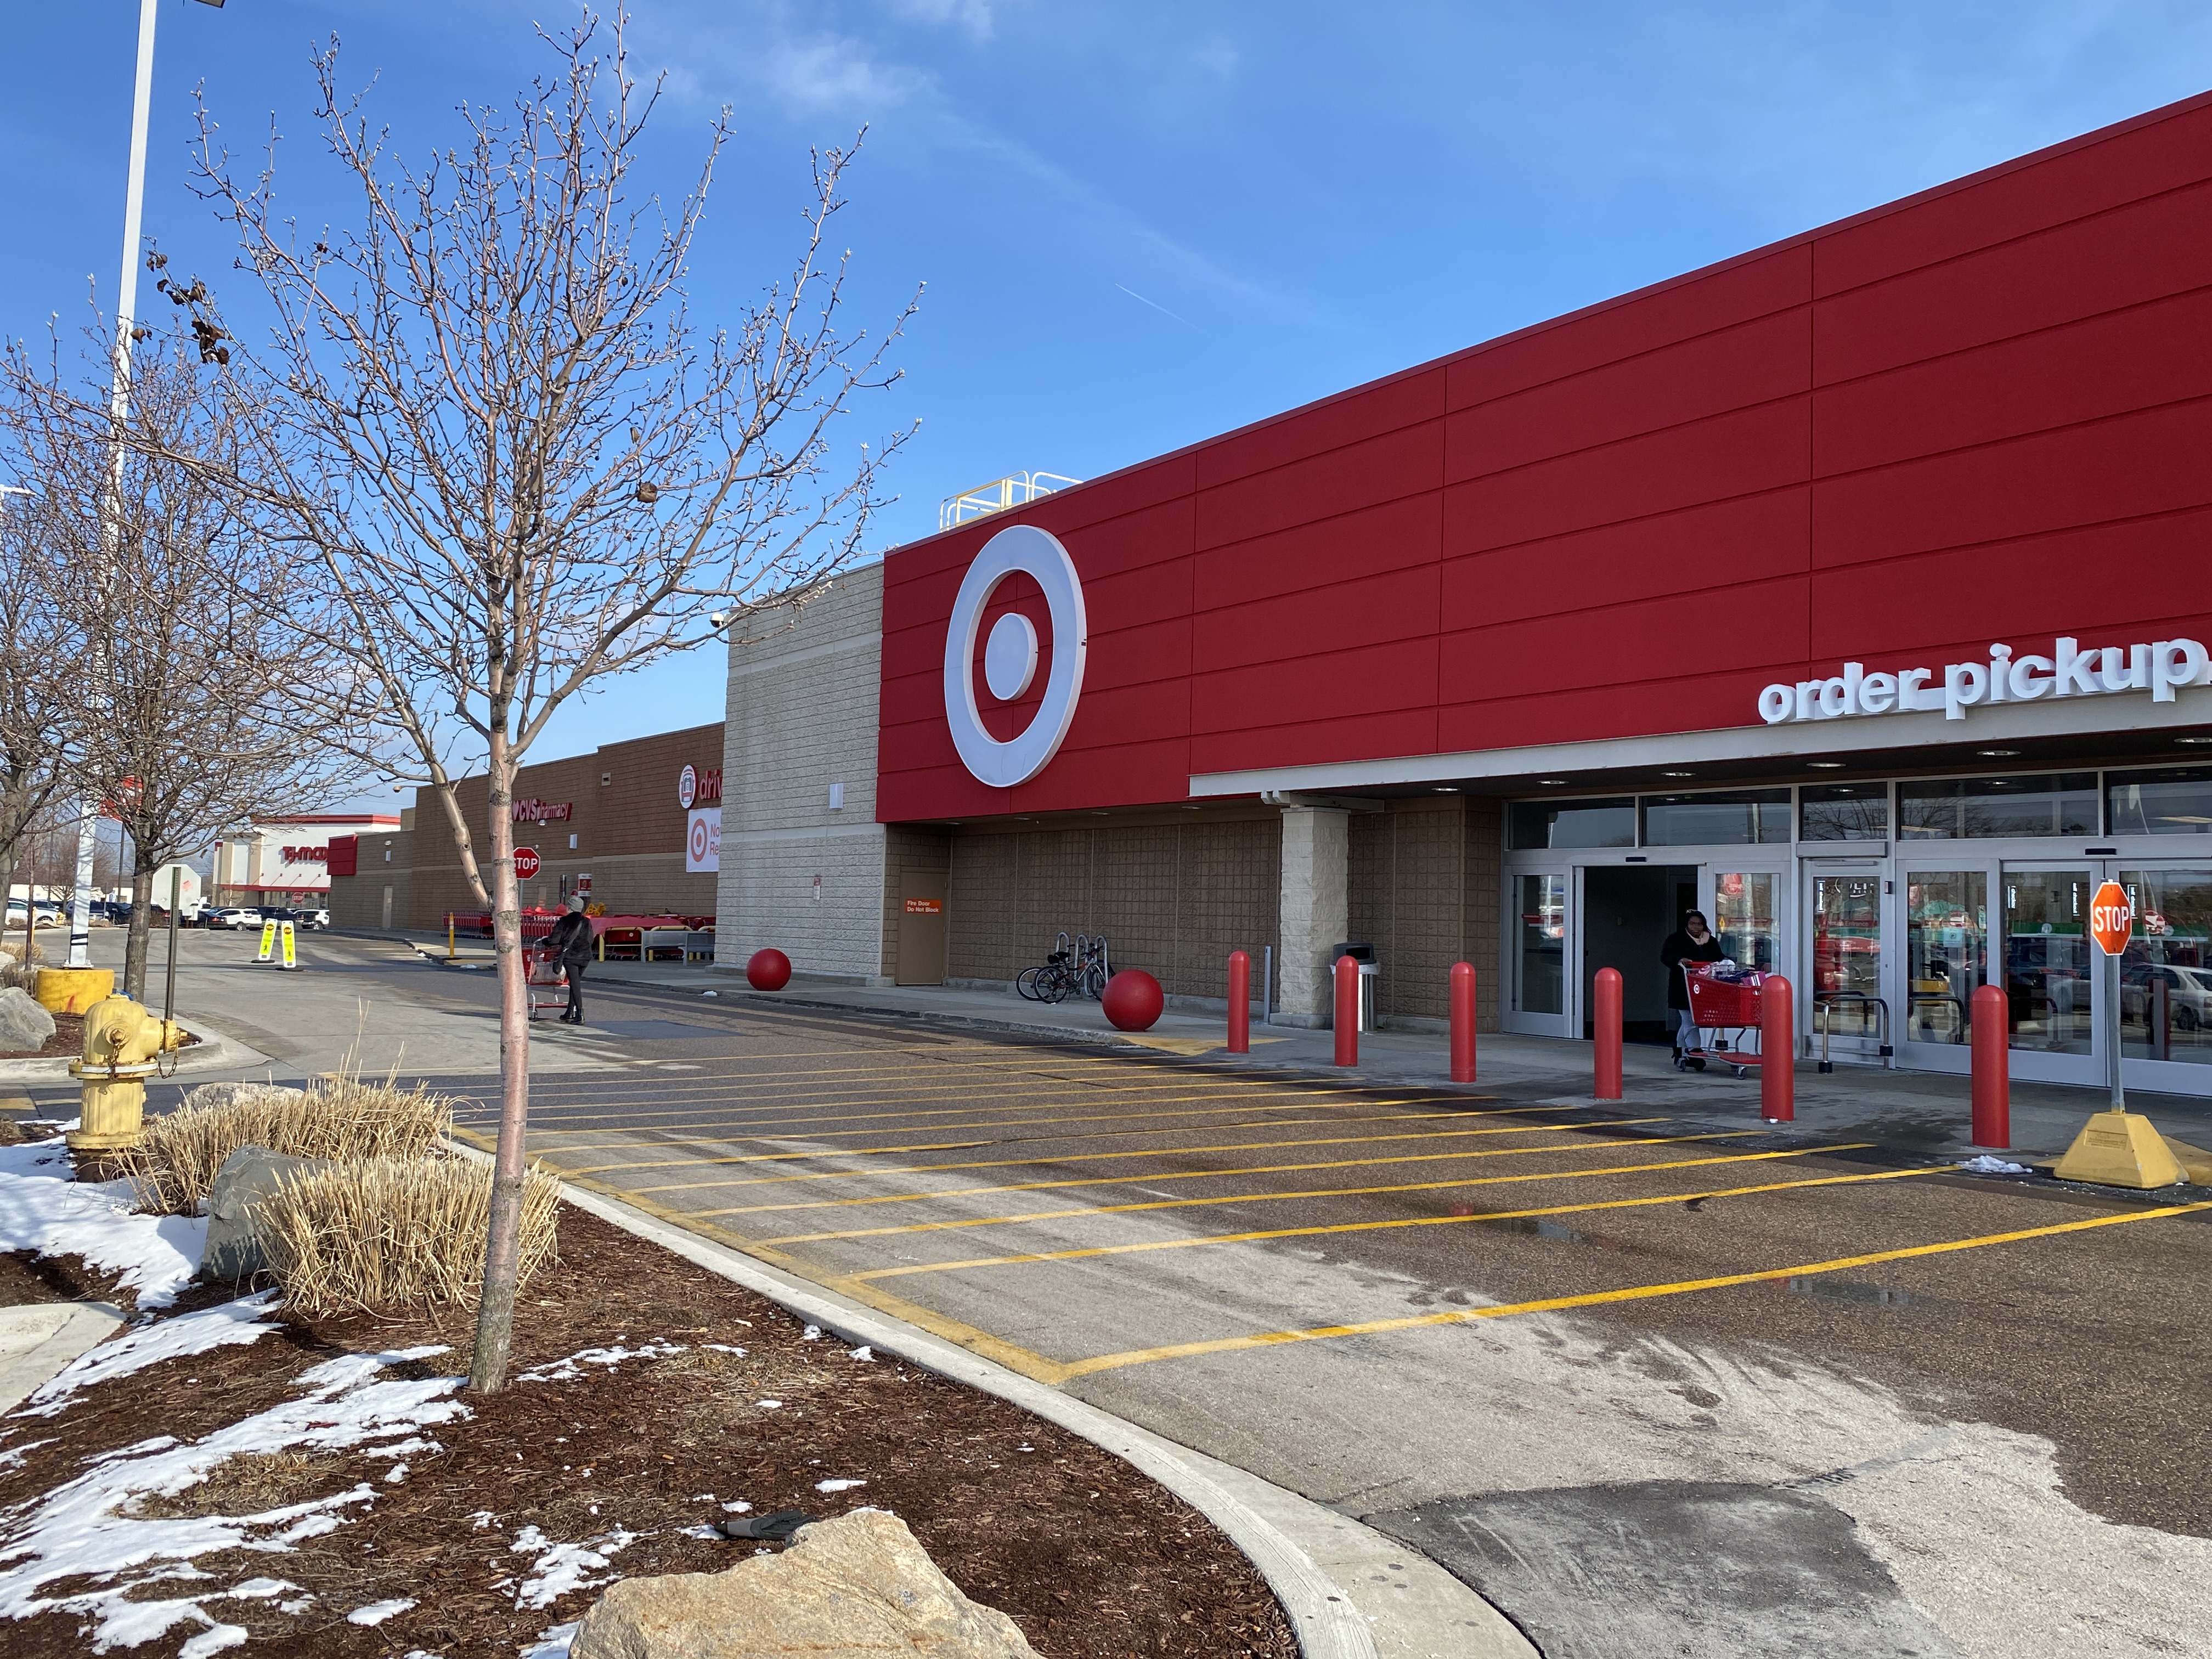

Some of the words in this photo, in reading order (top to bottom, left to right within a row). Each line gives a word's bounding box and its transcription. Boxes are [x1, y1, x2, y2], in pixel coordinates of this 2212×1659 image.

[1758, 662, 1931, 724] order
[1945, 636, 2209, 720] pickup
[519, 798, 540, 821] CVS
[537, 802, 572, 823] pharmacy
[2095, 906, 2129, 932] STOP
